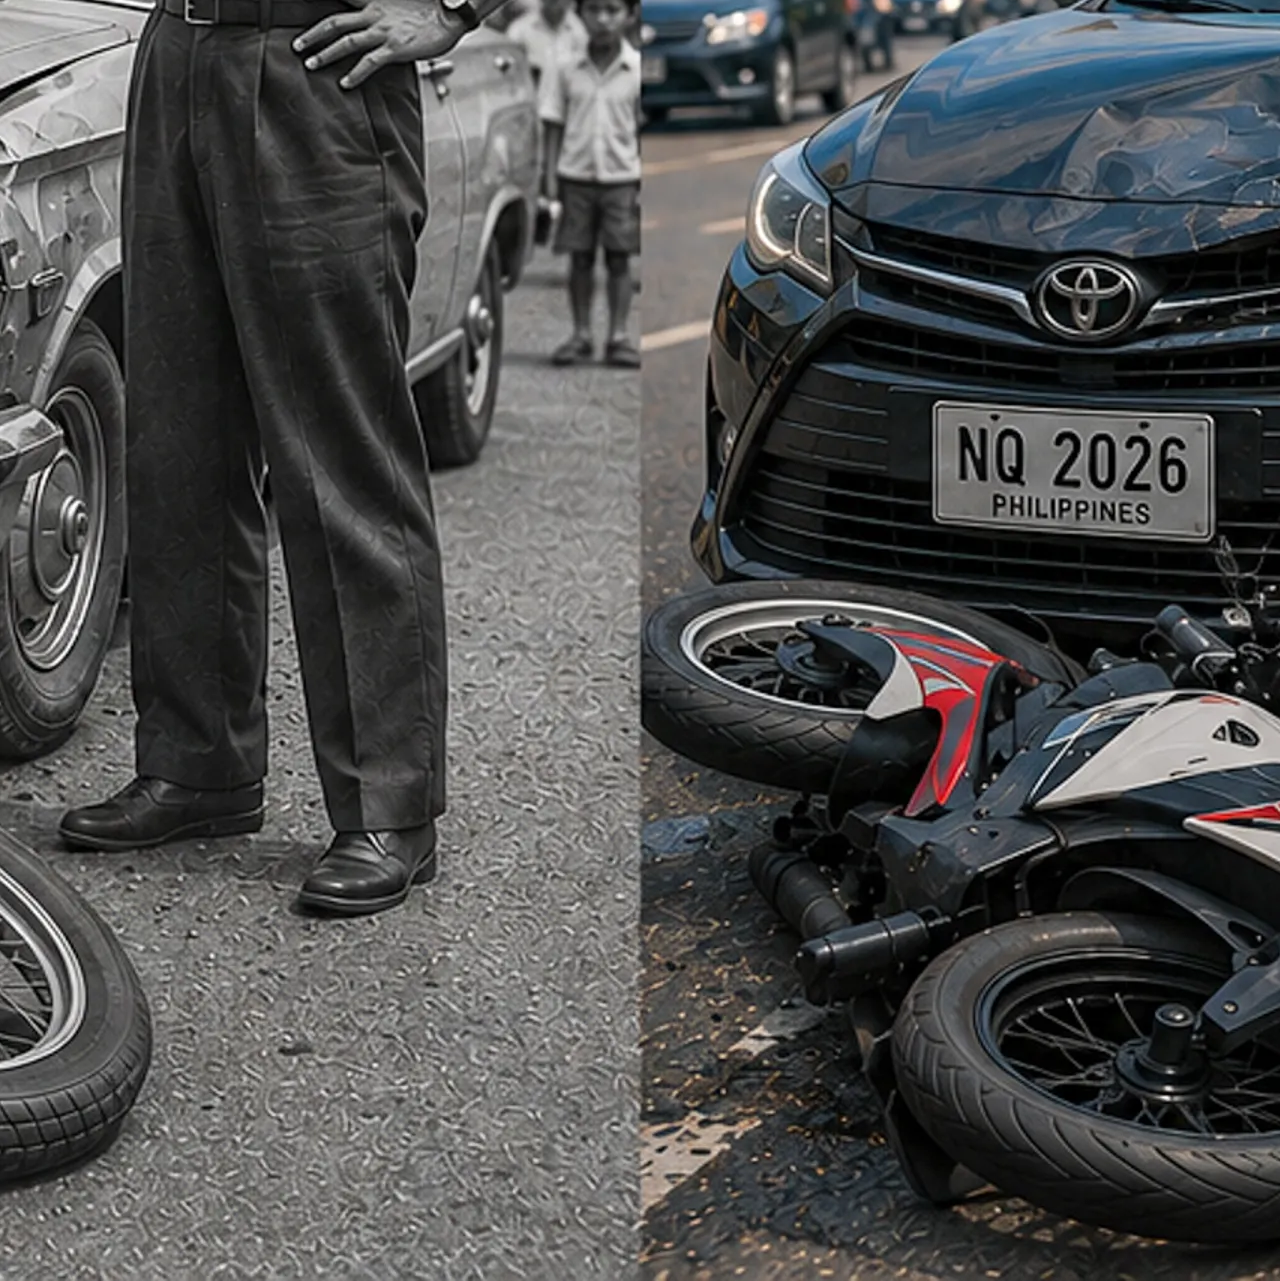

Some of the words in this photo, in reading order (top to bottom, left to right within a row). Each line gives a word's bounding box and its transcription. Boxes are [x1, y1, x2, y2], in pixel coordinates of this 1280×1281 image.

[957, 425, 1026, 487] NQ
[1053, 430, 1187, 494] 2026
[992, 493, 1151, 525] PHILIPPINES
